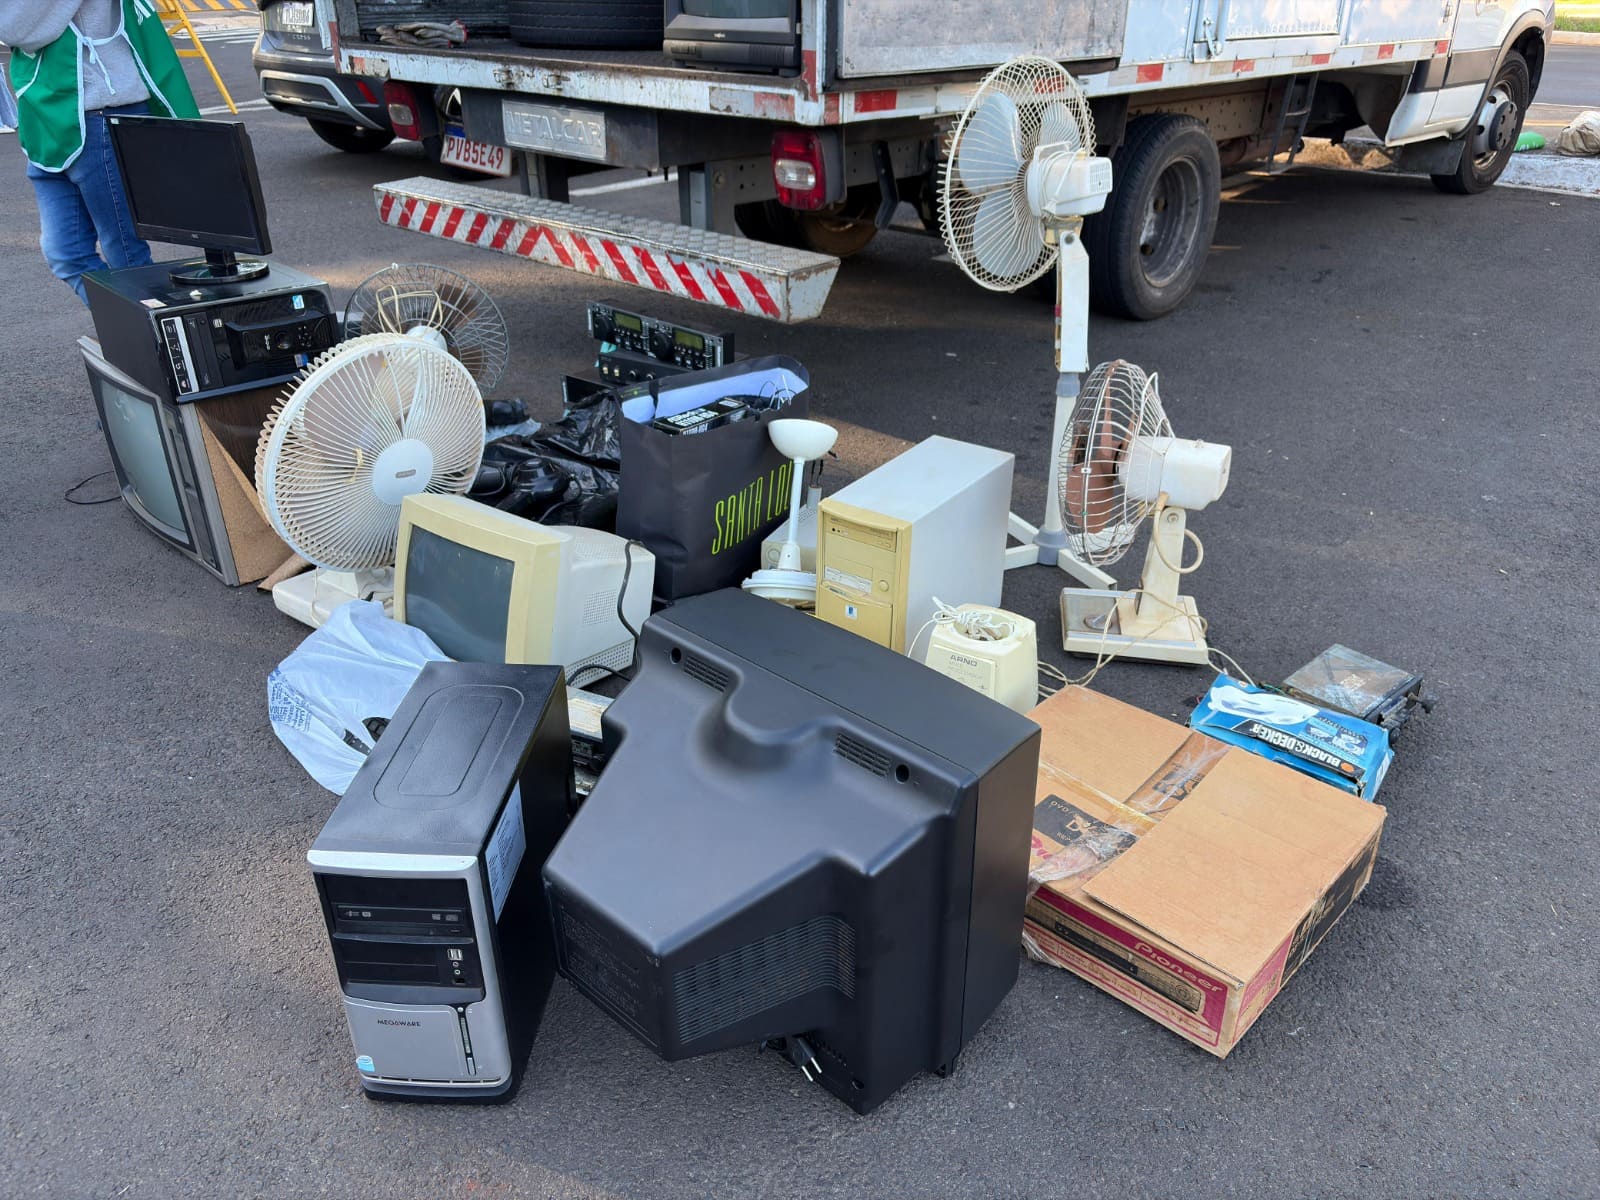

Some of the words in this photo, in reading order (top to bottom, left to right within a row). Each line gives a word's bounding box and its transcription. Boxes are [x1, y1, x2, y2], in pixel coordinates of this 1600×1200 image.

[446, 136, 505, 171] PVB5E49
[711, 476, 764, 556] SANTA
[766, 459, 794, 522] LOL
[950, 654, 978, 668] ARNO
